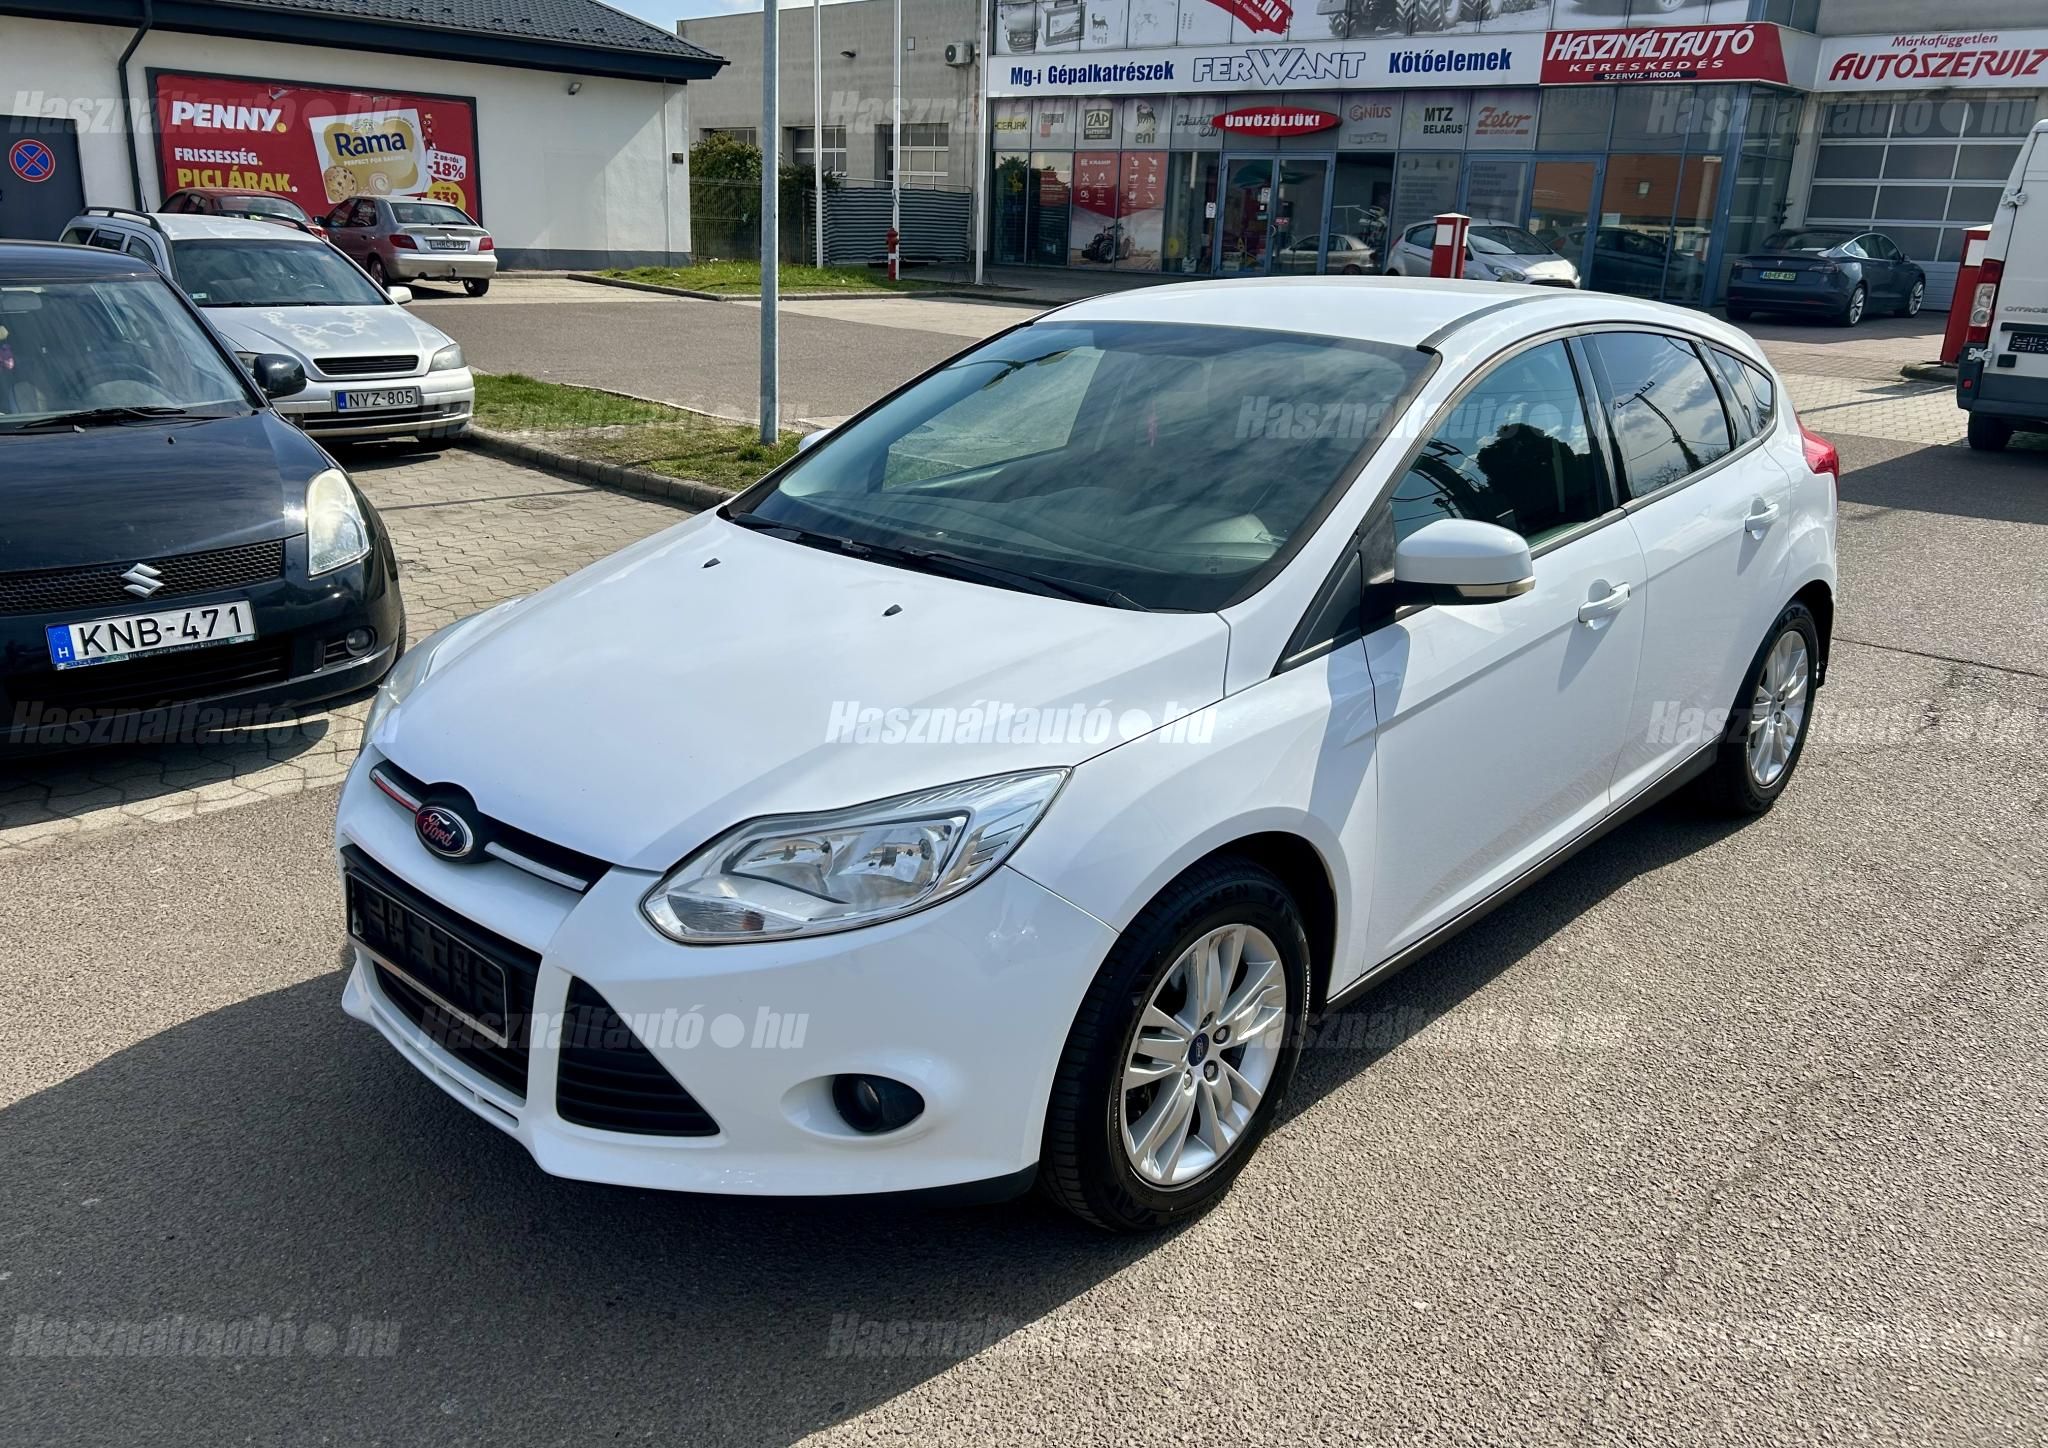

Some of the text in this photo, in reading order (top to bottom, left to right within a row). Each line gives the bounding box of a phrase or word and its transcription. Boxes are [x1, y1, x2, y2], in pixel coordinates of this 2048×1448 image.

[1547, 25, 1754, 61] HASZNÁLTAUTÓ
[1892, 33, 1998, 48] Márkafüggetlen
[1389, 48, 1513, 73] Kötőelemek
[1569, 59, 1724, 72] KERESKEDÉS
[1828, 48, 2048, 82] AUTÓSZERVIZ
[1010, 60, 1175, 87] Mg-i Gépalkatrészek
[1086, 111, 1109, 128] ZAP
[1225, 113, 1320, 128] ÜDVÖZÖLJÜK!
[1424, 107, 1454, 122] MTZ
[1478, 106, 1531, 128] Zetor
[1135, 131, 1155, 144] eni
[1423, 124, 1463, 135] BELARUS
[333, 132, 407, 157] Rama
[174, 147, 263, 166] FRISSESSÉG.
[177, 168, 223, 188] PICI
[427, 161, 465, 179] -18%
[349, 390, 413, 407] NYZ-805
[79, 605, 242, 656] KNB-471
[57, 647, 70, 659] H
[422, 812, 457, 847] Ford
